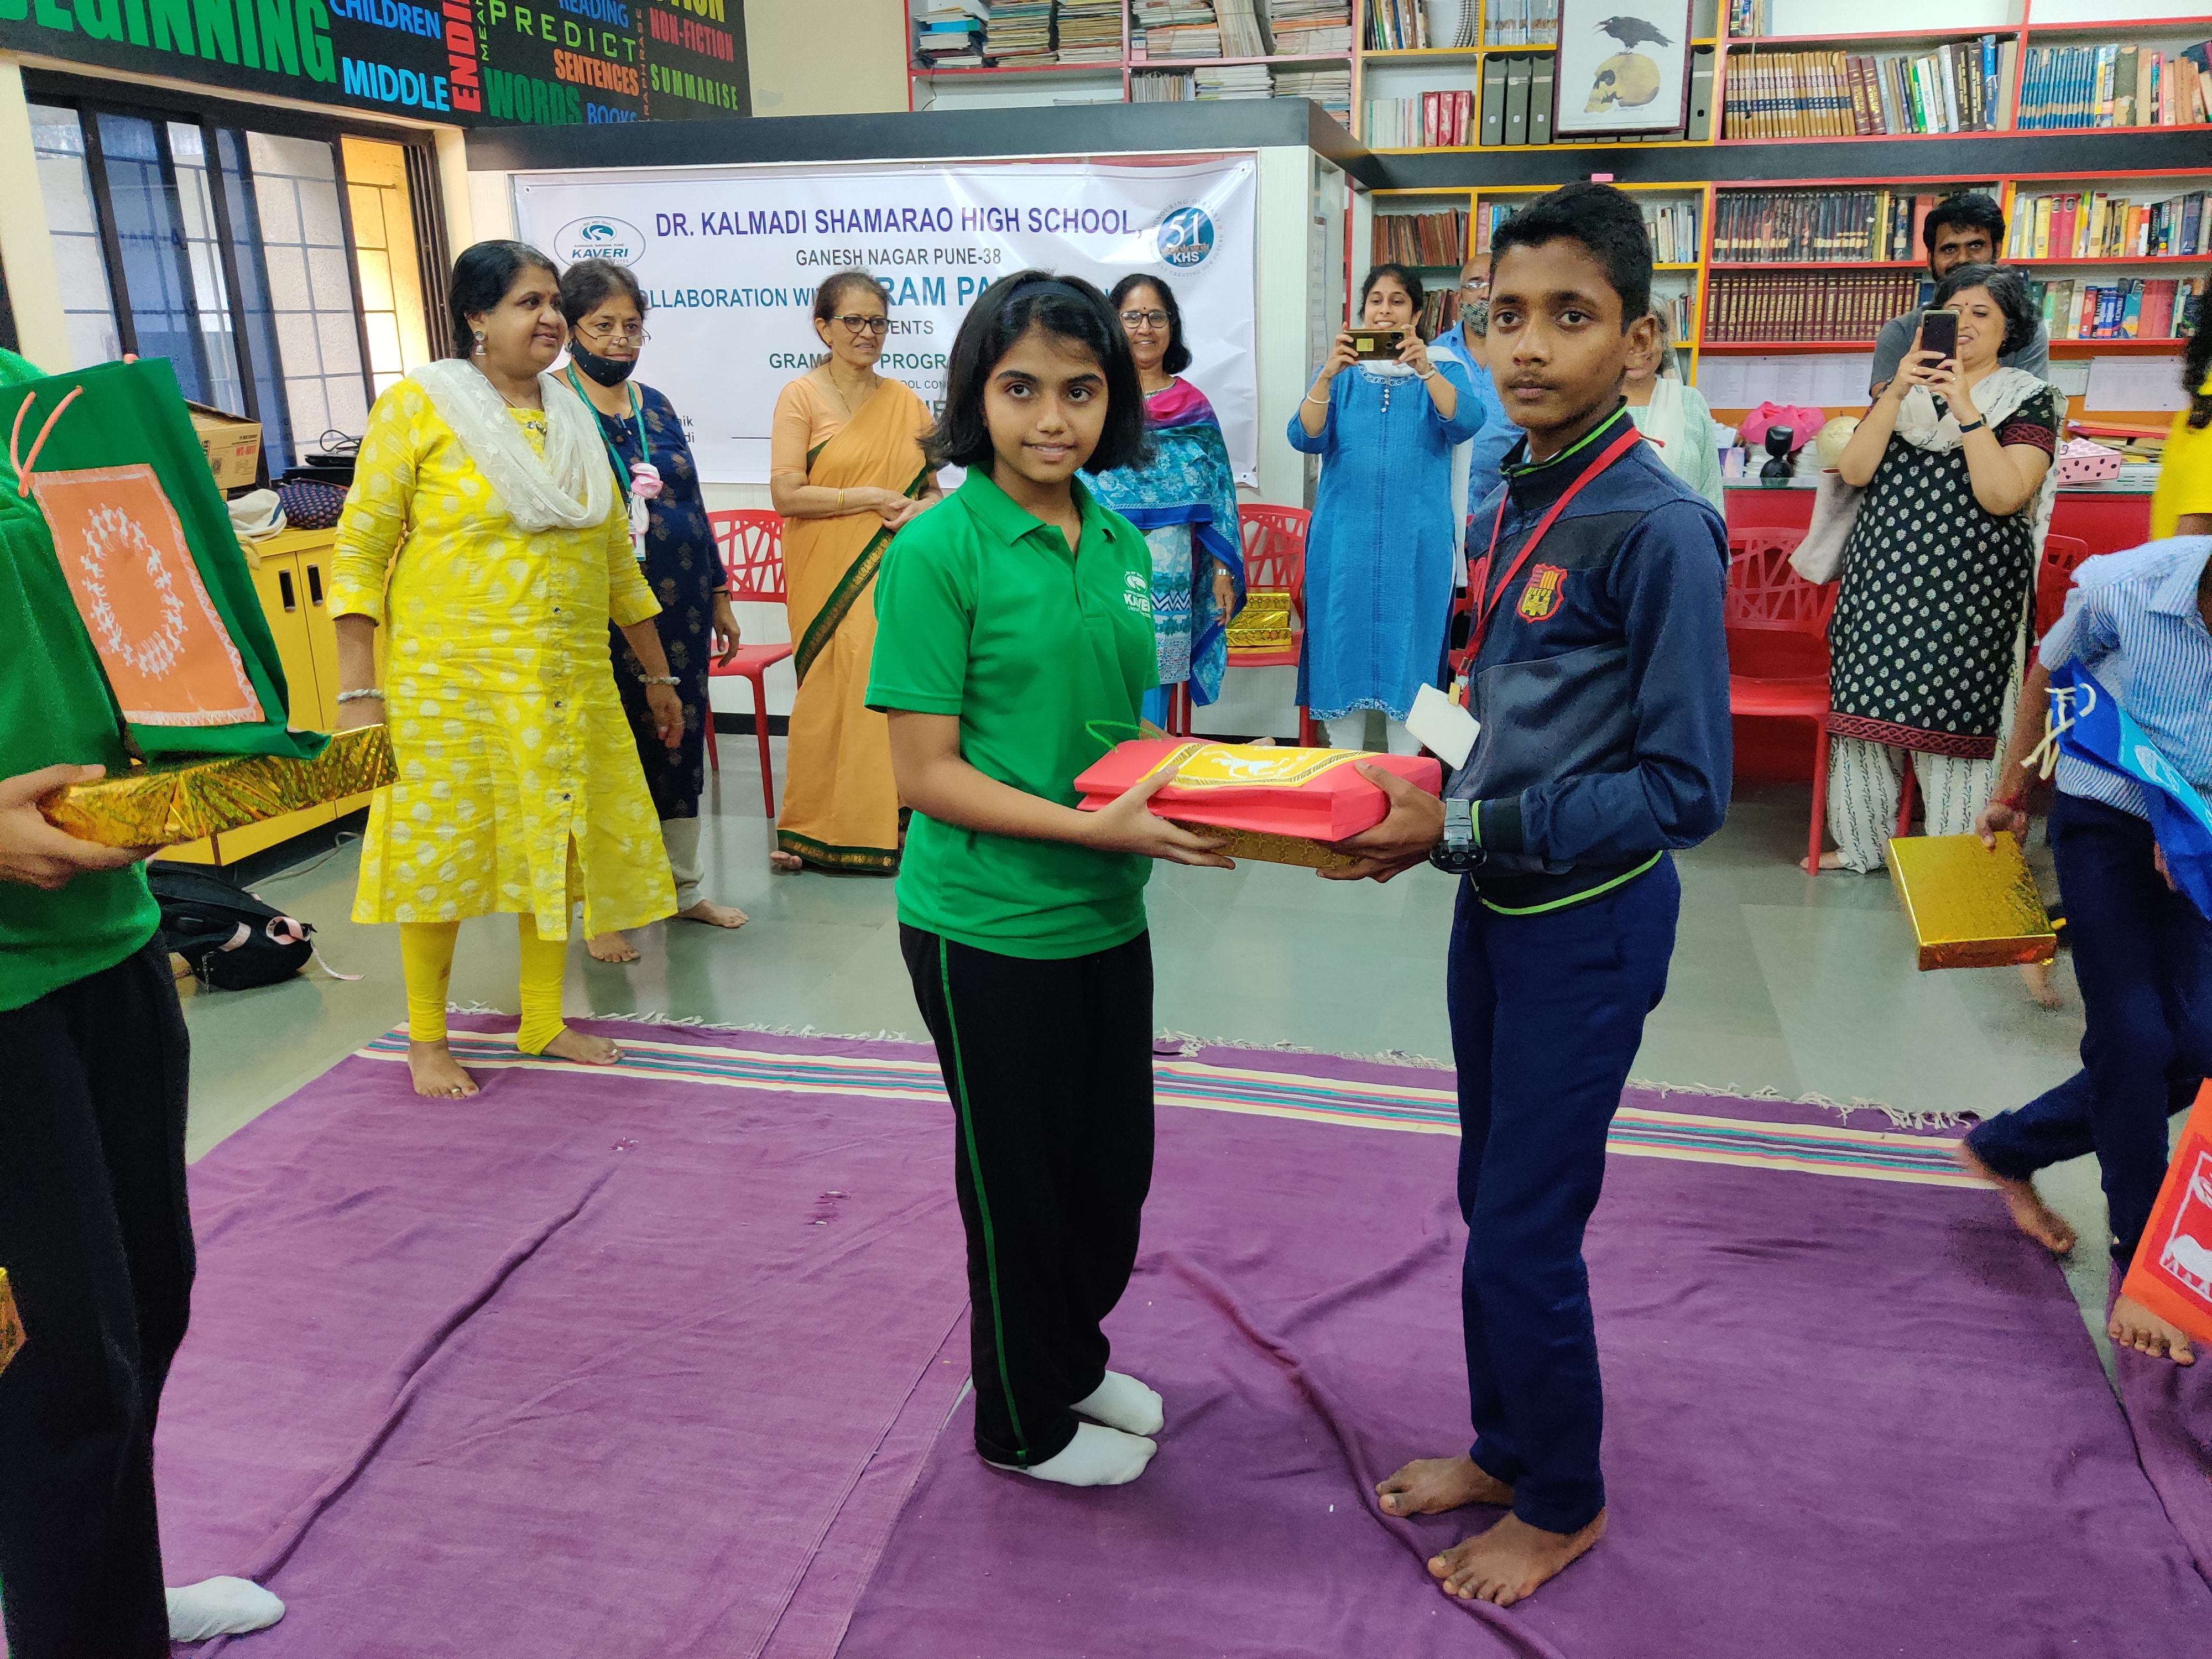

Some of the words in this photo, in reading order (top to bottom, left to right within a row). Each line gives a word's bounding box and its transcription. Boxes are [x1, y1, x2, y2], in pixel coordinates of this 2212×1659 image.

[0, 0, 336, 83] INNING
[489, 0, 636, 62] PREDICT
[650, 7, 733, 62] NON-FICTION
[443, 0, 481, 112] ENDI
[554, 49, 639, 96] SENTENCES
[342, 56, 450, 112] MIDDLE
[483, 67, 582, 126] WORDS
[650, 64, 738, 111] SUMMARISE
[656, 213, 695, 237] DR.
[702, 210, 806, 236] KALMADI
[815, 207, 952, 233] SHAMARAO
[962, 207, 1020, 233] HIGH
[1029, 208, 1142, 239] SCHOOL,
[1166, 211, 1204, 248] 51
[572, 248, 628, 258] KAVERI
[796, 249, 864, 266] GANESH
[869, 248, 928, 265] NAGAR
[934, 247, 1001, 265] PUNE-38
[1173, 252, 1199, 263] KHS
[639, 288, 786, 308] OLLABORATION
[792, 288, 817, 306] WI
[875, 276, 946, 306] RAM
[957, 276, 993, 306] PA
[889, 320, 933, 334] ENTS
[770, 353, 825, 369] GRAM
[880, 353, 948, 369] PROGR
